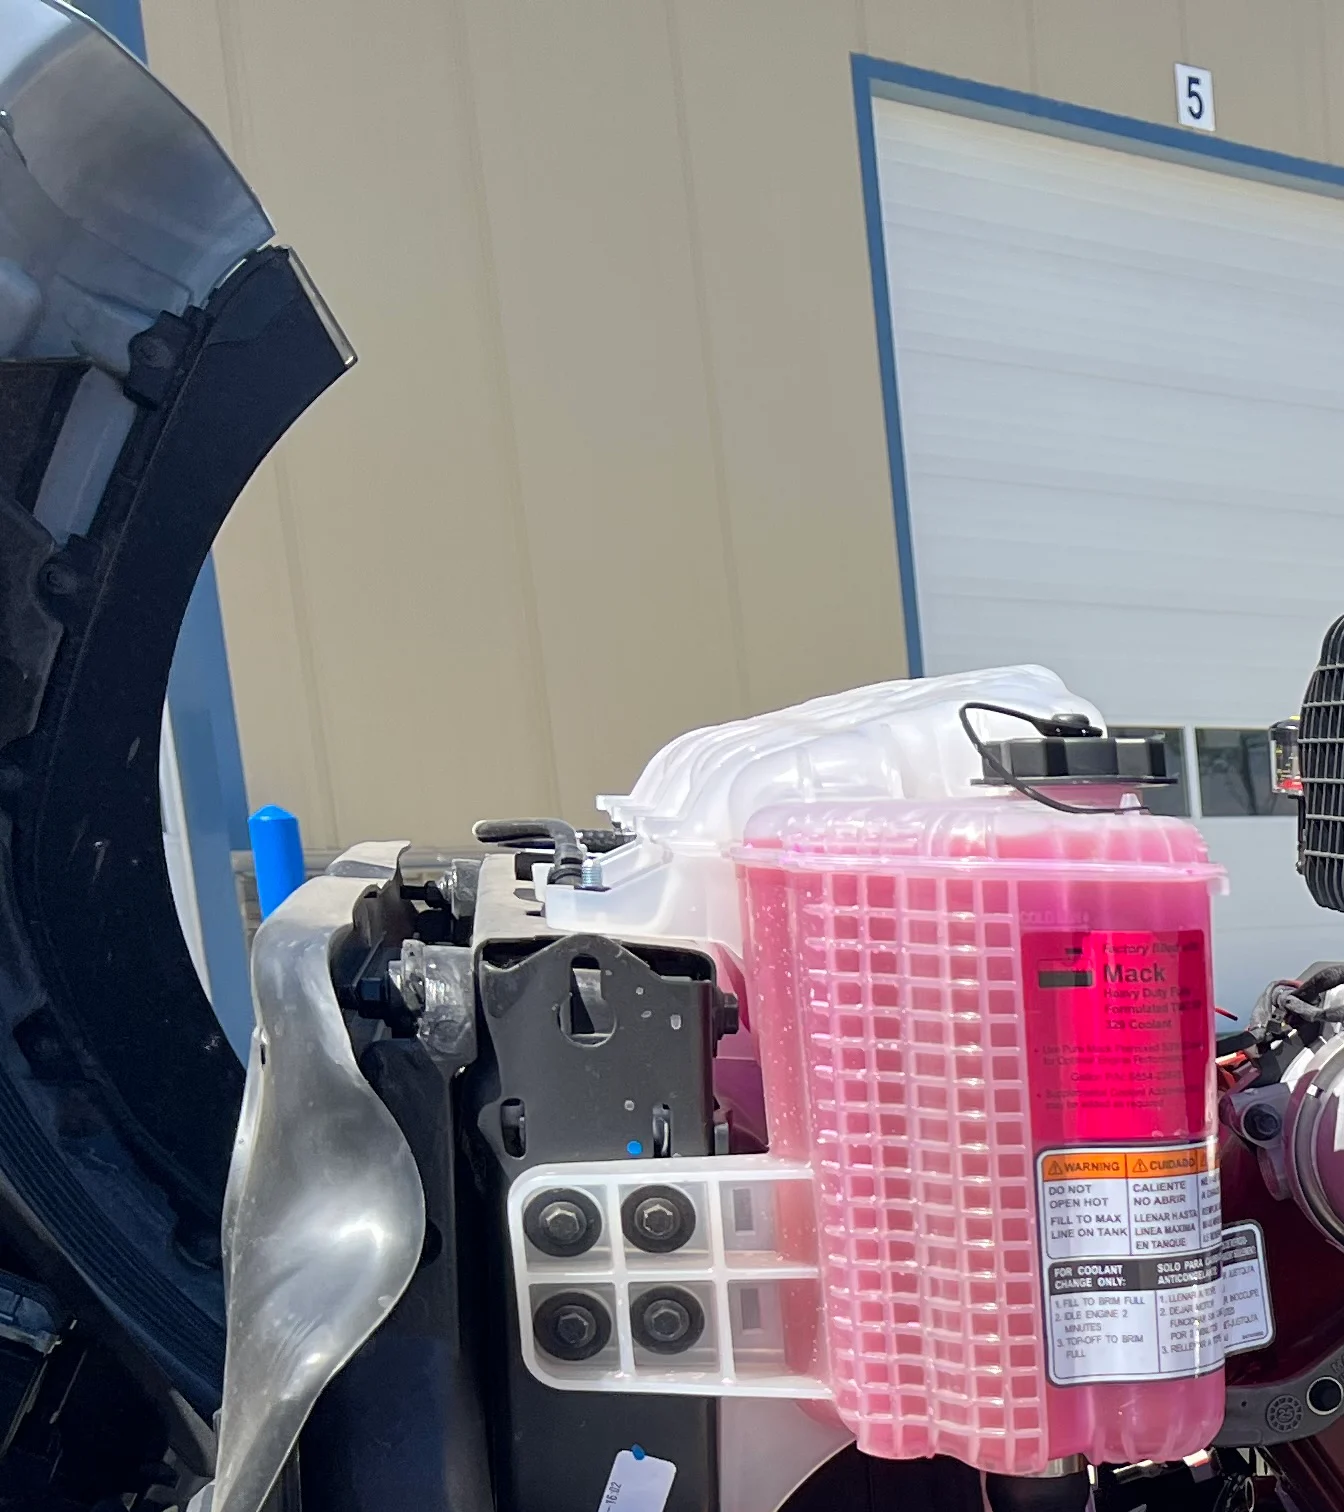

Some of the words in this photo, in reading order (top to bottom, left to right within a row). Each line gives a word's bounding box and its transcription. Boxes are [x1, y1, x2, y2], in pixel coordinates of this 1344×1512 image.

[1188, 76, 1203, 120] 5
[1103, 963, 1166, 983] Mack
[1104, 989, 1139, 1000] Heavy
[1143, 989, 1166, 999] Duty
[1129, 1019, 1172, 1029] Coolant
[1065, 1161, 1120, 1172] WARNING
[1150, 1158, 1195, 1170] CUIDADO
[1049, 1186, 1064, 1195] DO
[1068, 1184, 1091, 1194] NOT
[1133, 1181, 1186, 1193] CALIENTE
[1050, 1199, 1081, 1209] OPEN
[1084, 1198, 1109, 1207] HOT
[1134, 1197, 1150, 1206] NO
[1154, 1194, 1186, 1205] ABRIR
[1051, 1216, 1073, 1226] FILL
[1077, 1215, 1092, 1224] TO
[1096, 1214, 1121, 1223] MAX
[1134, 1212, 1171, 1223] LLENAR
[1172, 1210, 1198, 1220] HASTA
[1051, 1229, 1075, 1239] LINE
[1078, 1228, 1094, 1237] ON
[1097, 1228, 1128, 1237] TANK
[1135, 1226, 1162, 1236] LINEA
[1136, 1241, 1149, 1250] EN
[1151, 1238, 1186, 1248] TANQUE
[1054, 1268, 1072, 1277] FOR
[1077, 1265, 1123, 1275] COOLANT
[1157, 1263, 1180, 1273] SOLO
[1184, 1259, 1203, 1270] PARA
[1054, 1278, 1093, 1289] CHANGE
[1097, 1277, 1126, 1287] ONLY:
[1063, 1300, 1079, 1308] FILL
[1082, 1298, 1095, 1306] TO
[1099, 1297, 1120, 1305] BRIM
[1124, 1296, 1146, 1304] FULL
[1086, 1310, 1118, 1319] ENGINE
[1123, 1309, 1128, 1318] 2
[1065, 1323, 1102, 1333] MINUTES
[1105, 1335, 1118, 1344] TO
[1122, 1334, 1143, 1343] BRIM
[1066, 1350, 1085, 1358] FULL
